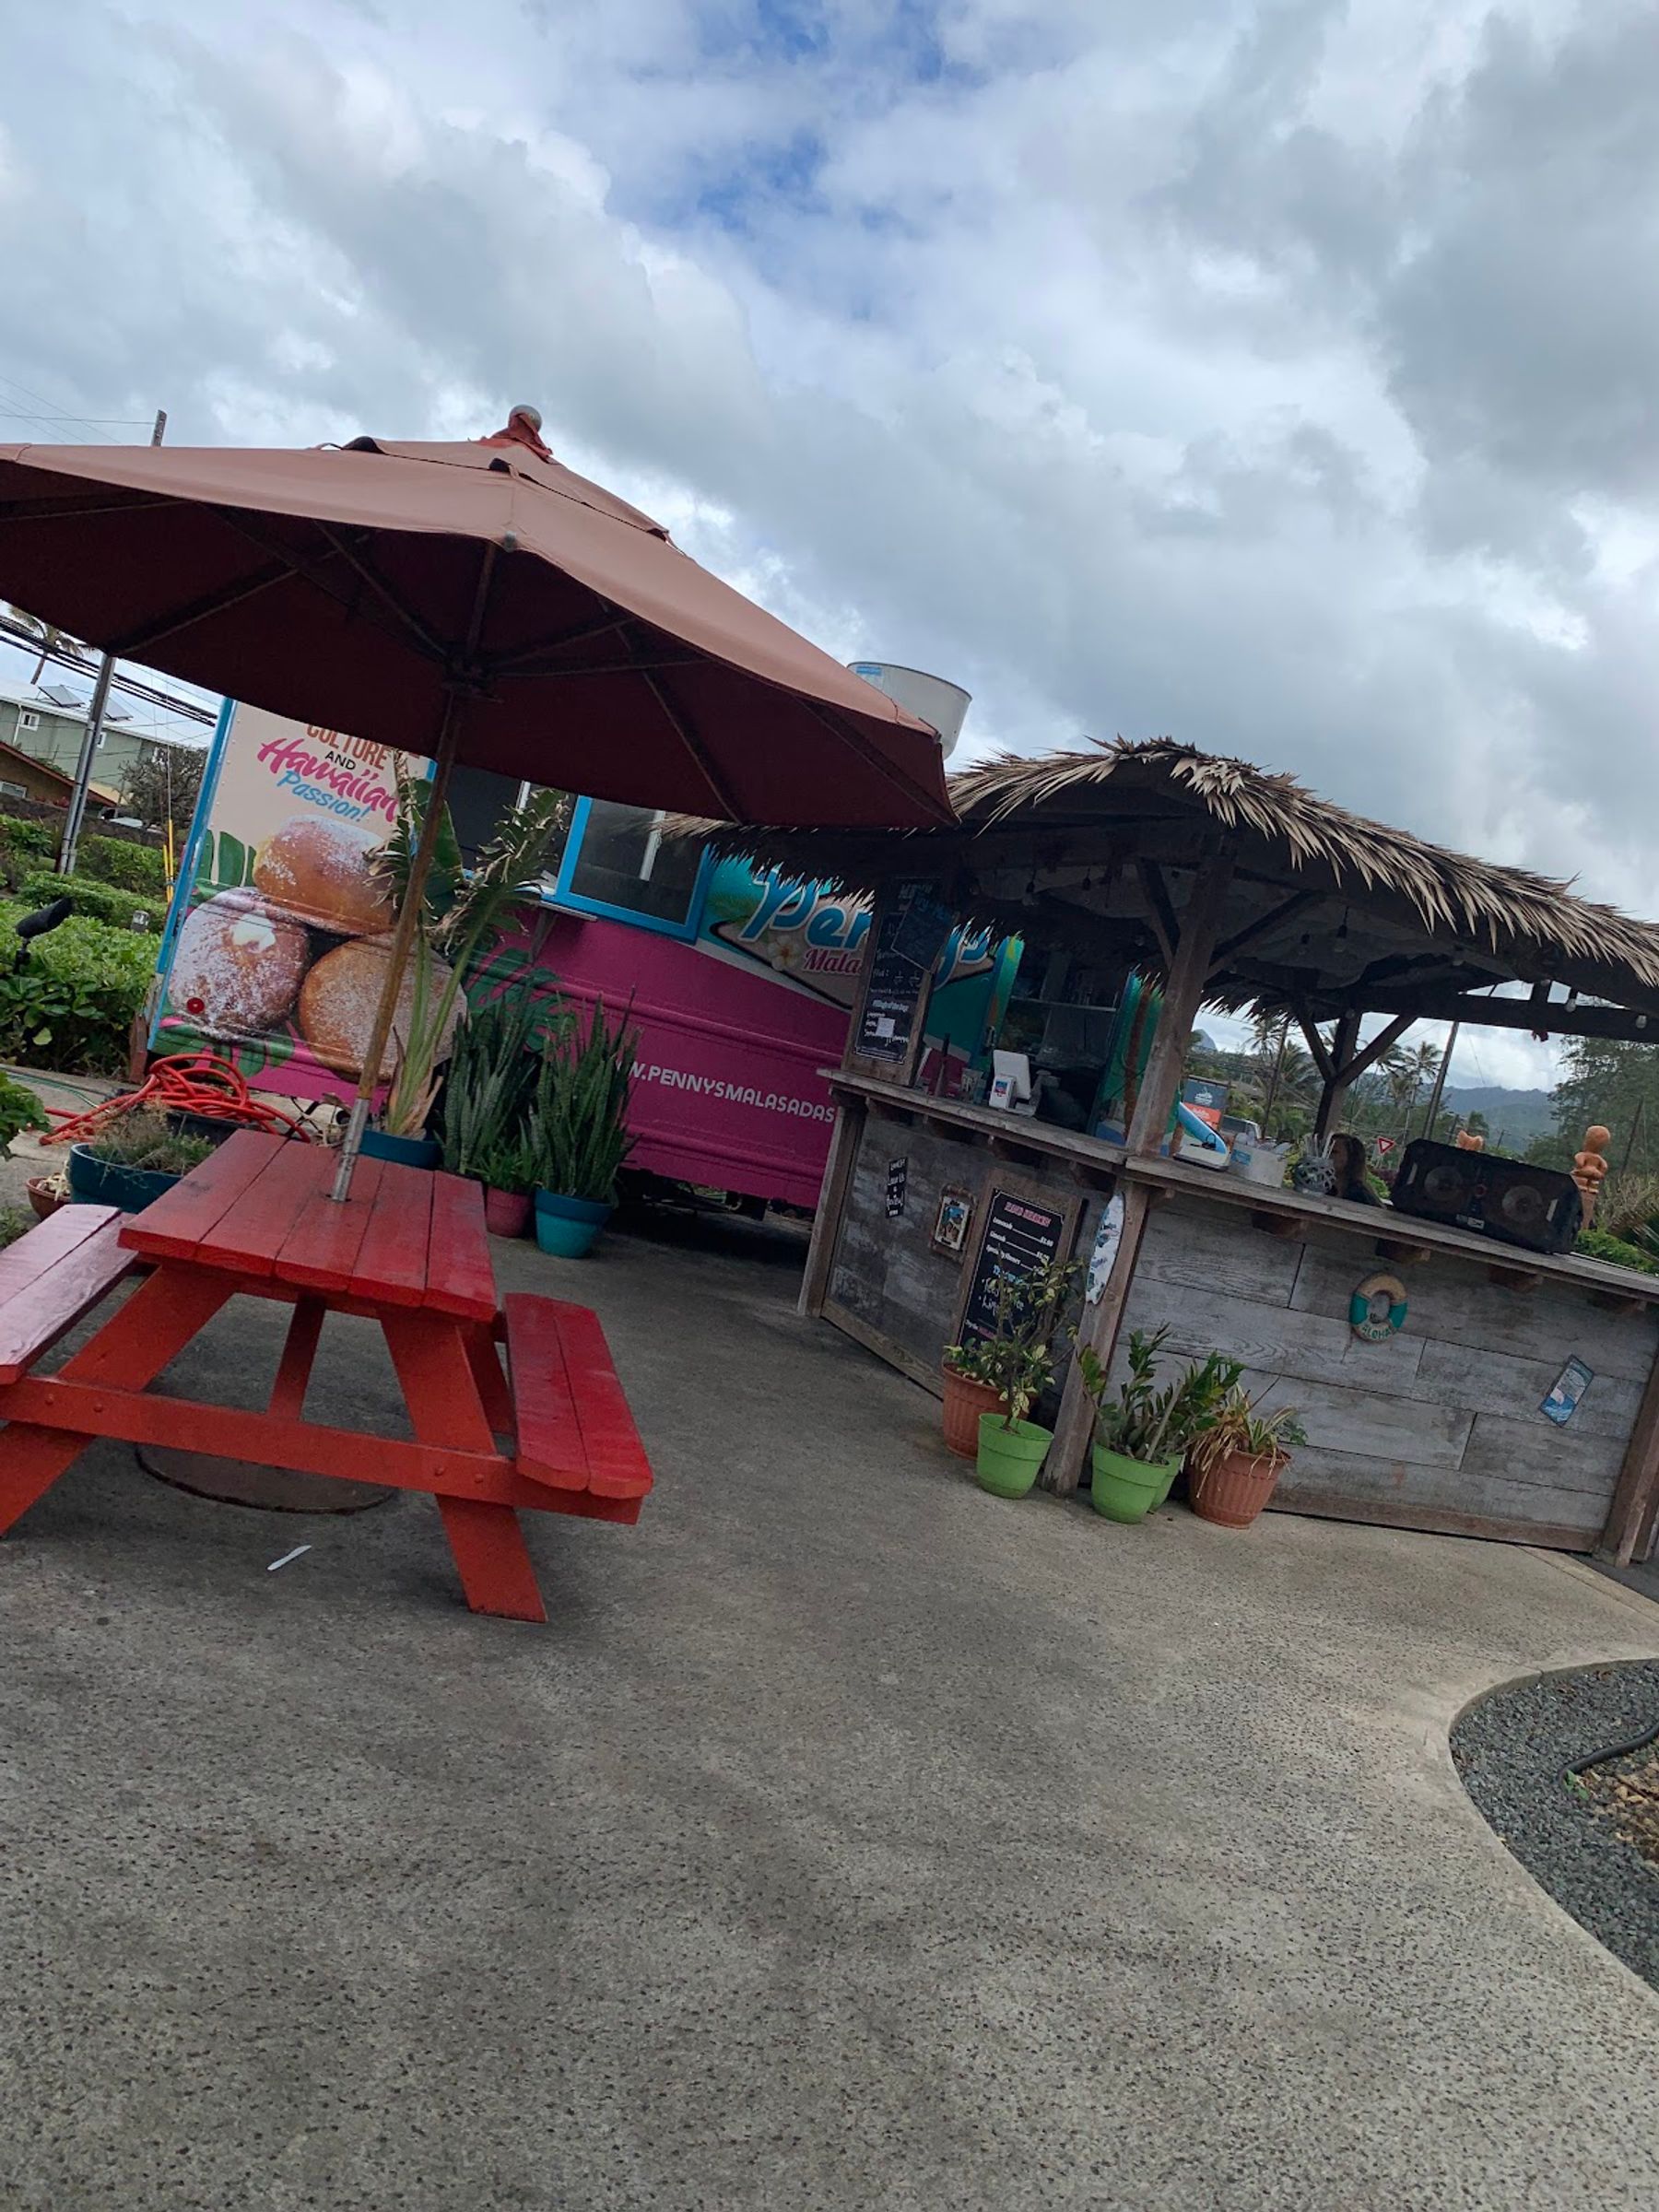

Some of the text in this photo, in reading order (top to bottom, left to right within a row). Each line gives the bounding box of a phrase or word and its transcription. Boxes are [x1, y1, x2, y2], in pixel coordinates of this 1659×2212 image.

[256, 737, 398, 822] Hawaiian
[324, 750, 357, 771] AND
[276, 770, 372, 822] Passion!
[803, 947, 863, 974] Mala
[616, 1060, 835, 1123] W.PENNYSMALASADAS
